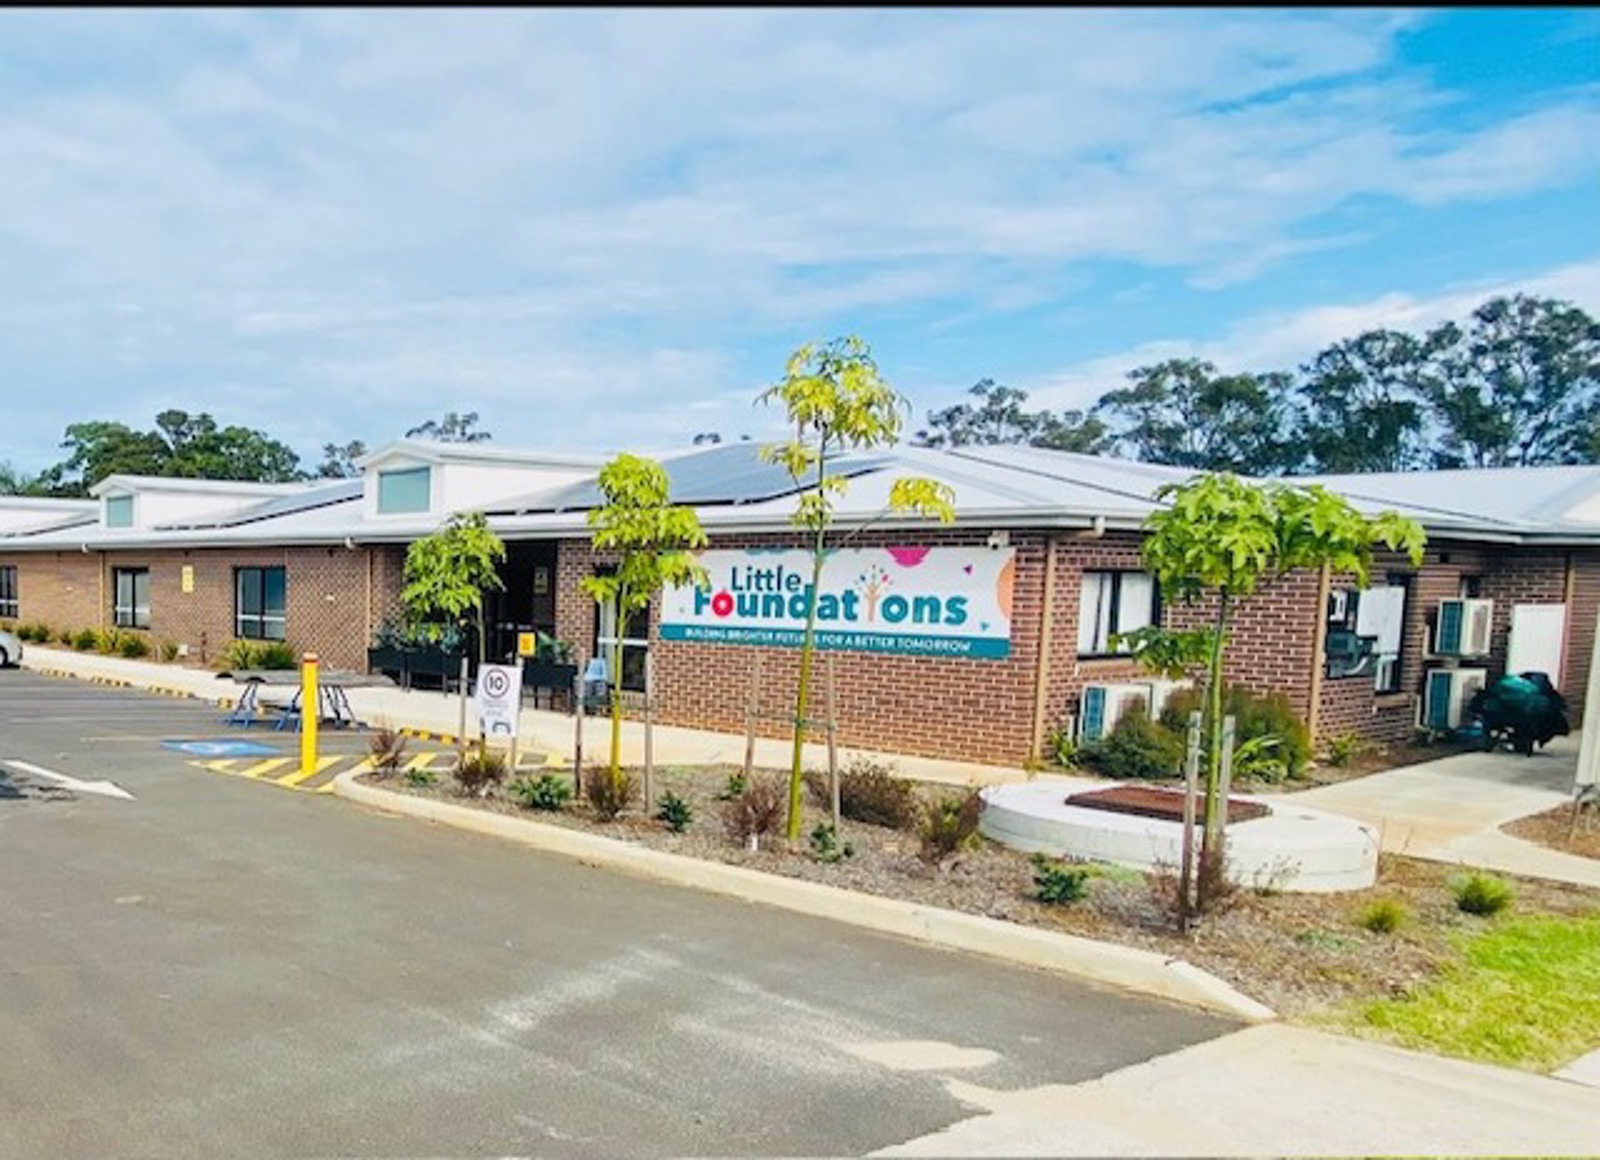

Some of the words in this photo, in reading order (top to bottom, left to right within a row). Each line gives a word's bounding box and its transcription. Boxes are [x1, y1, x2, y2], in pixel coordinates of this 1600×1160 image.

[731, 565, 801, 592] Little
[694, 583, 969, 626] Foundations
[684, 628, 726, 640] BUILDING
[727, 629, 773, 642] BRIGHTER
[774, 632, 820, 644] FUTURS
[822, 633, 842, 646] FOR
[844, 635, 854, 646] A
[854, 635, 895, 649] BETTER
[897, 638, 972, 653] TOMORROW
[489, 677, 503, 691] 10
